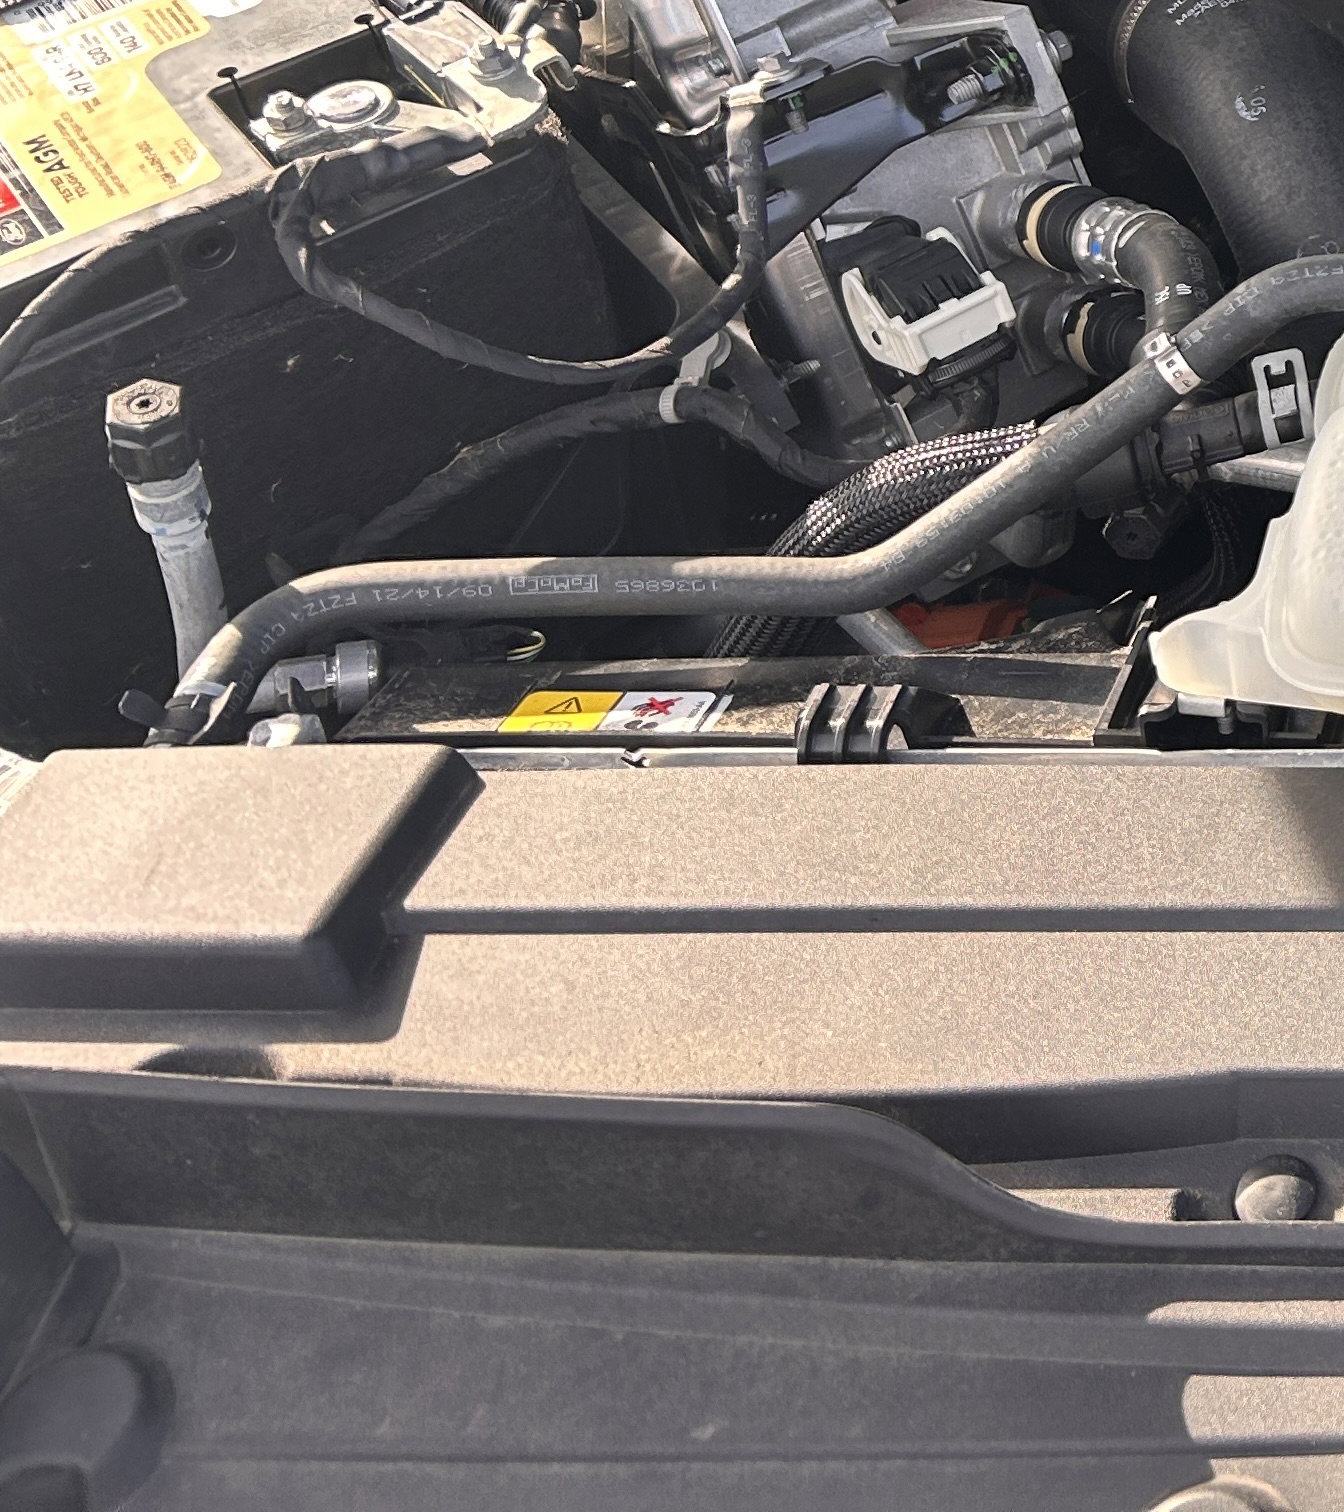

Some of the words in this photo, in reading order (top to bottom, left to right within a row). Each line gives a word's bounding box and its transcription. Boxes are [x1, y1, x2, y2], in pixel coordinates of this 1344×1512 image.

[22, 133, 71, 174] AGM
[50, 175, 77, 204] TESTED
[370, 583, 492, 602] 09/14/21
[511, 574, 594, 593] FoMoCo
